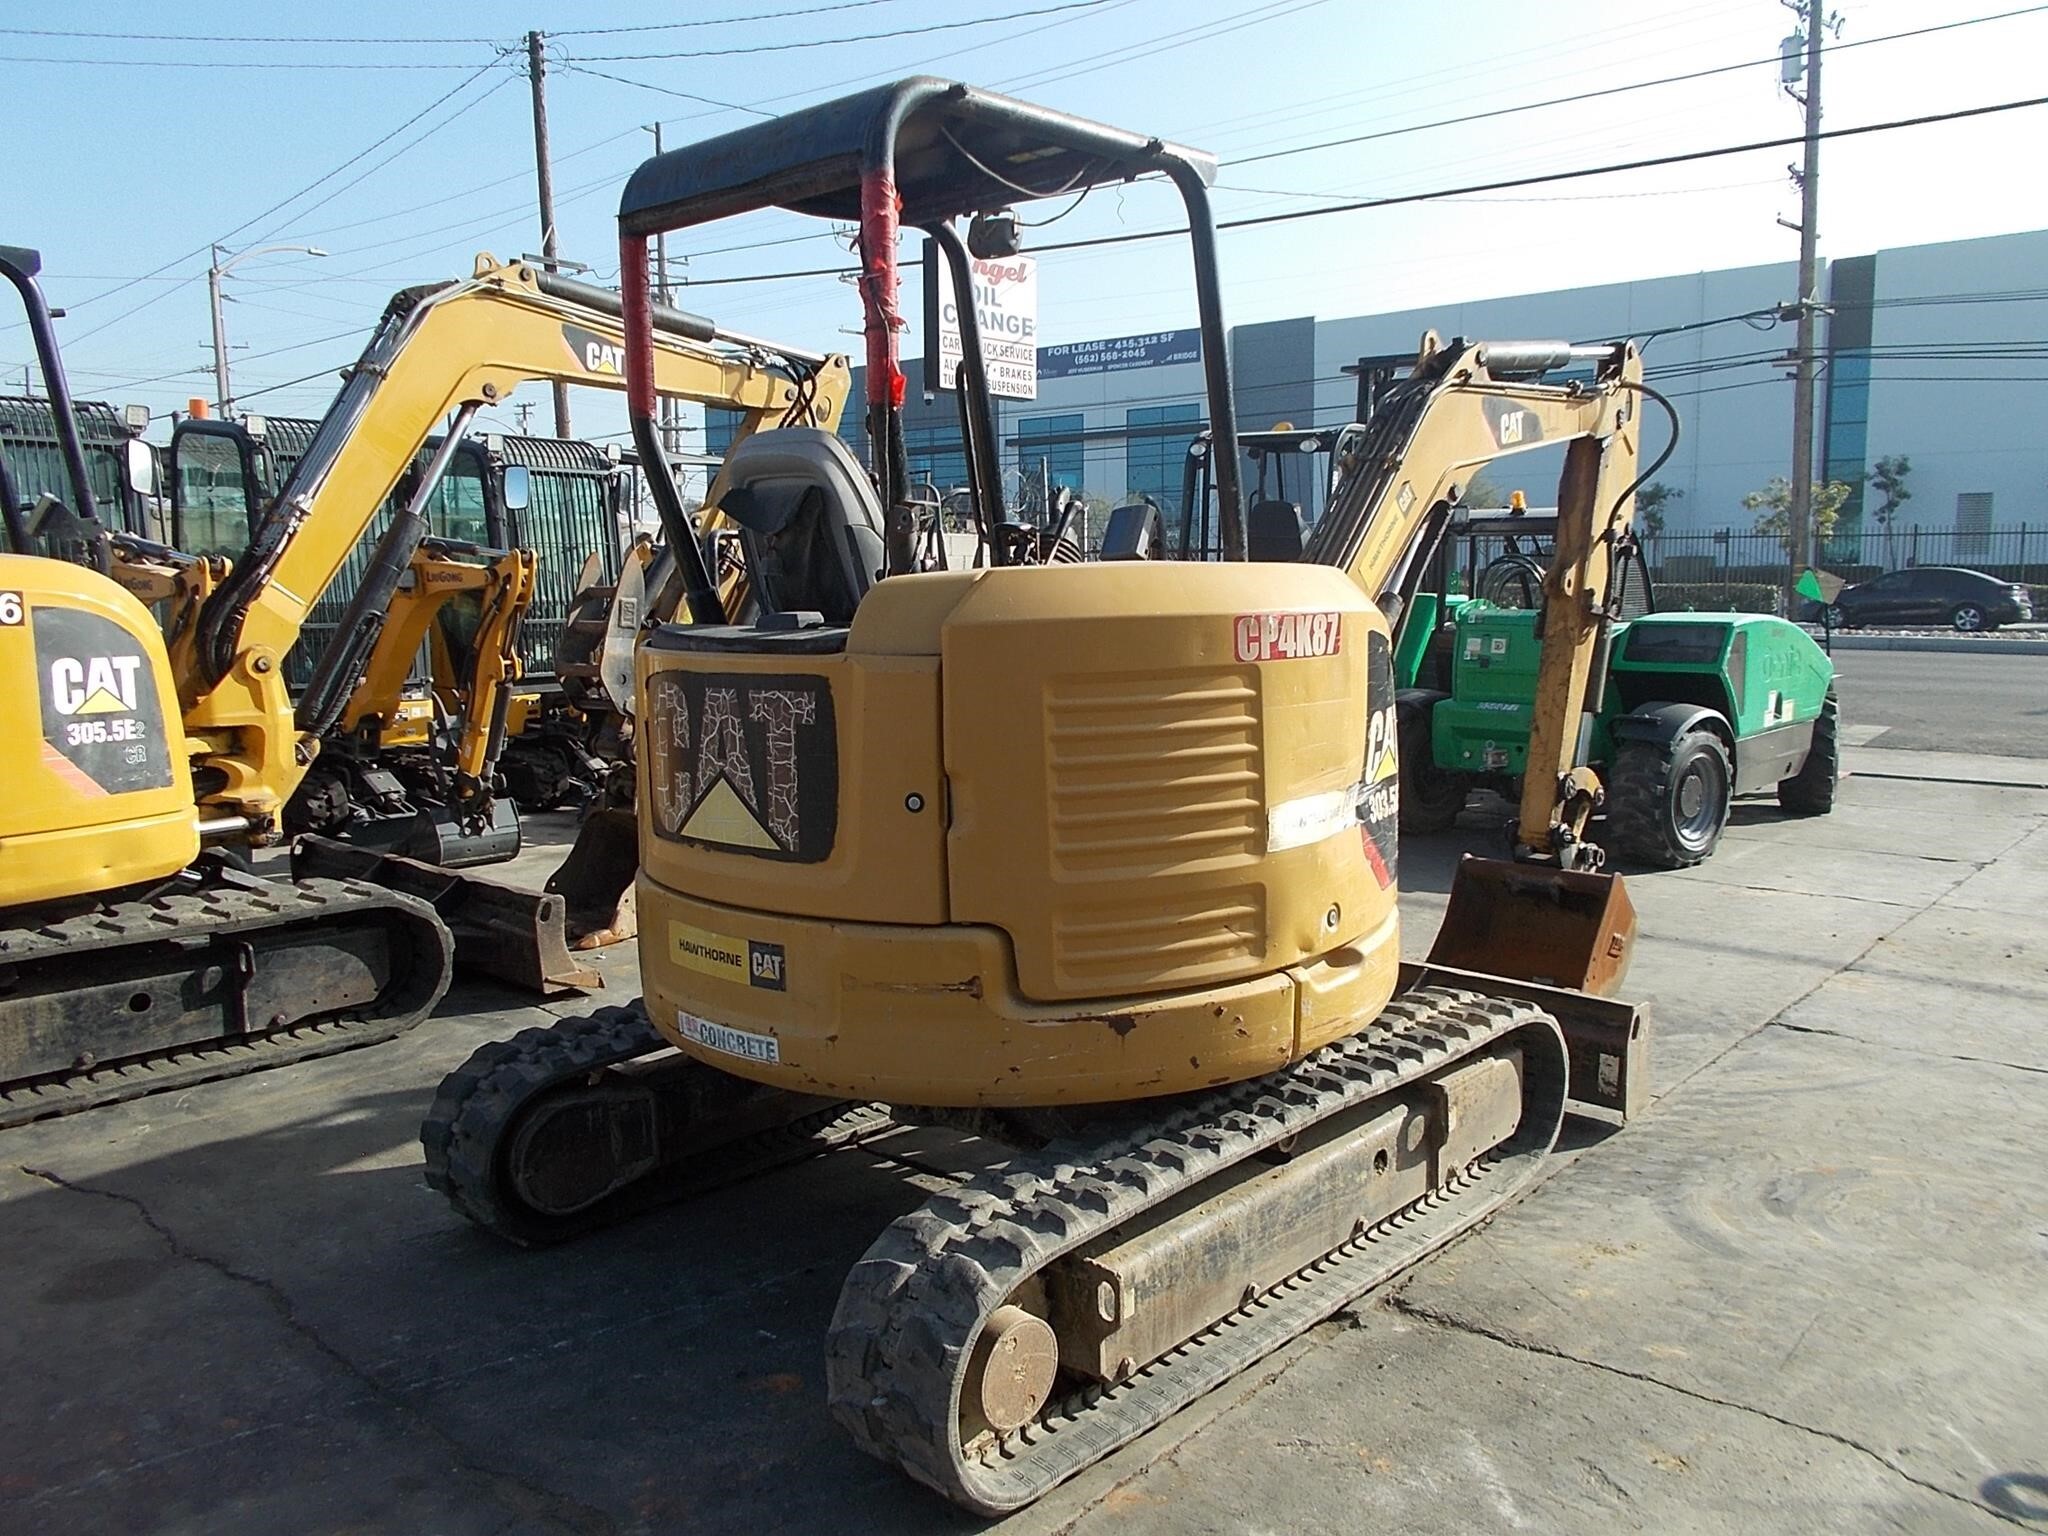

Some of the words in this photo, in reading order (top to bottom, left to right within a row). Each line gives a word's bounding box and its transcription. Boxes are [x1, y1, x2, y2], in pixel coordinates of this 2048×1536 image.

[972, 259, 1027, 285] ngel
[943, 303, 1033, 336] CANGE
[586, 341, 626, 375] CAT
[942, 335, 960, 351] CAR
[999, 345, 1033, 362] SERVICE
[1047, 346, 1069, 356] FOR
[1072, 341, 1105, 354] LEASE
[1160, 333, 1175, 343] SF
[1074, 352, 1099, 365] (562)
[999, 365, 1033, 382] BRAKES
[1500, 411, 1524, 444] CAT
[1237, 613, 1340, 662] CP4K87
[51, 655, 141, 715] CAT
[125, 744, 147, 764] CR
[653, 681, 816, 852] CAT
[679, 938, 742, 967] HAWTHORNE
[752, 951, 784, 981] CAT
[700, 1023, 776, 1060] CONCRETE
